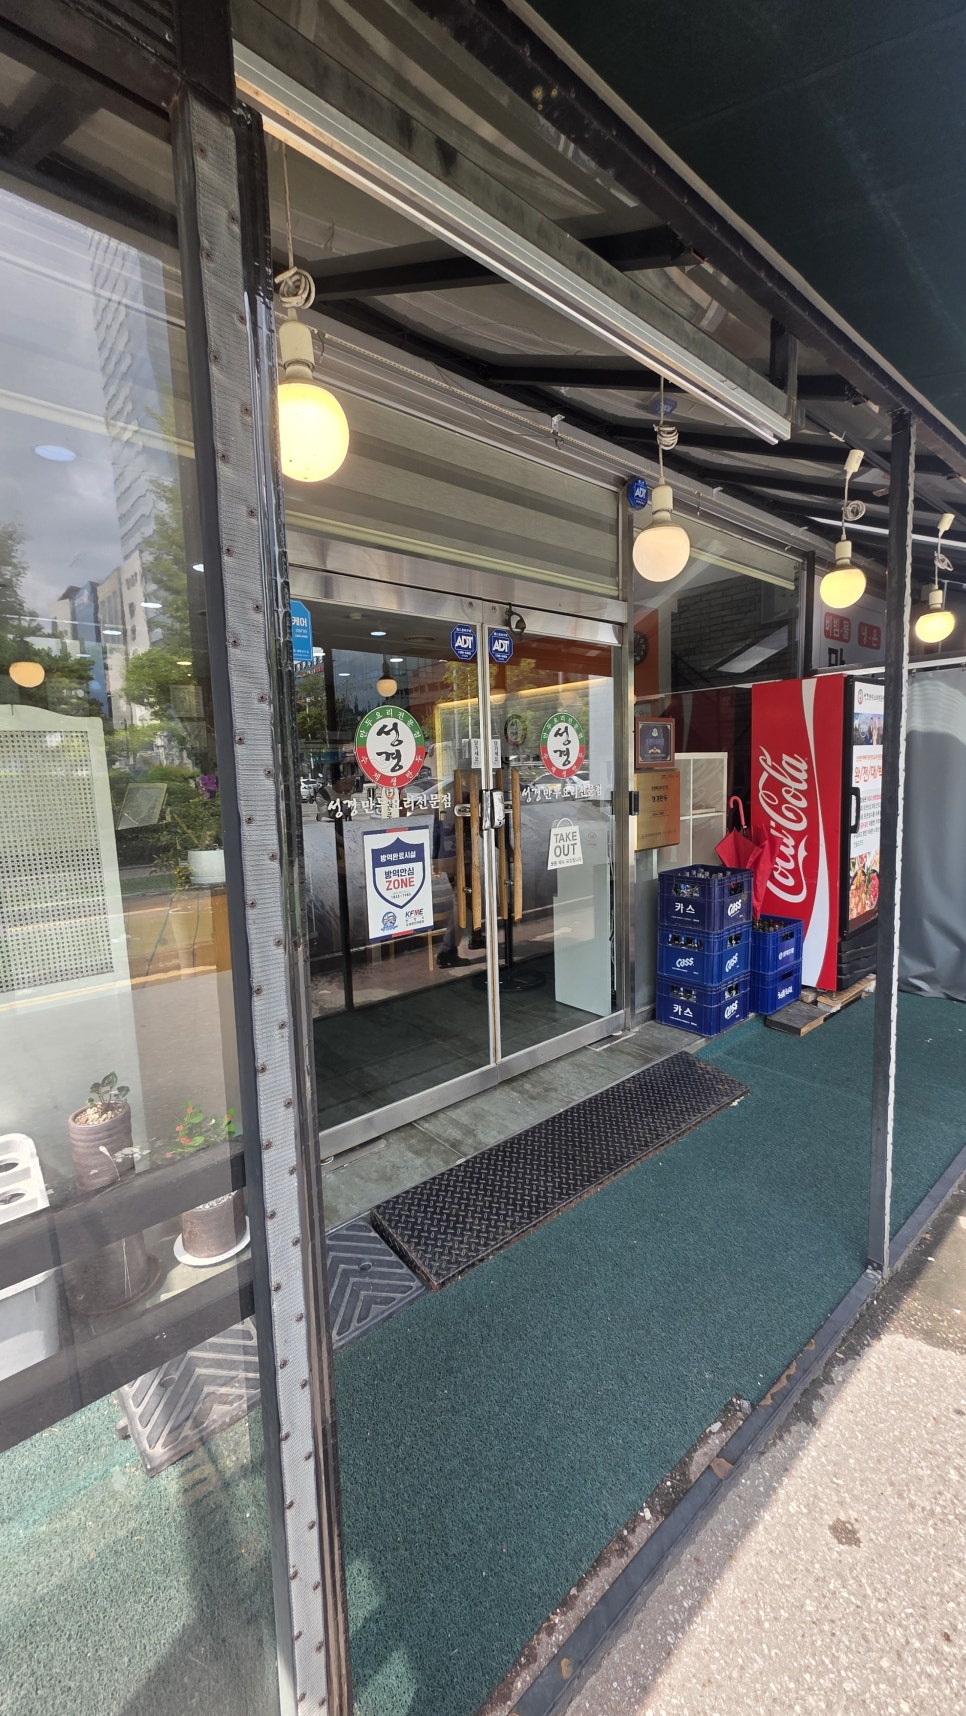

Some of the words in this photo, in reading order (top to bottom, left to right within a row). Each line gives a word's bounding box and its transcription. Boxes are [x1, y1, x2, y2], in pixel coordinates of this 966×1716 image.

[455, 635, 474, 649] ADT
[492, 639, 510, 652] ADT
[376, 722, 403, 773] 성경
[553, 726, 572, 767] 성경
[553, 831, 578, 843] TAKE
[380, 850, 417, 863] 방역완료시설
[553, 843, 578, 858] OUT
[384, 867, 415, 879] 방역안심
[385, 877, 416, 892] ZONE
[674, 902, 696, 914] 카스
[727, 899, 742, 916] Cass
[675, 957, 695, 968] Cass
[672, 1004, 694, 1018] 카스
[724, 1000, 739, 1018] Cass
